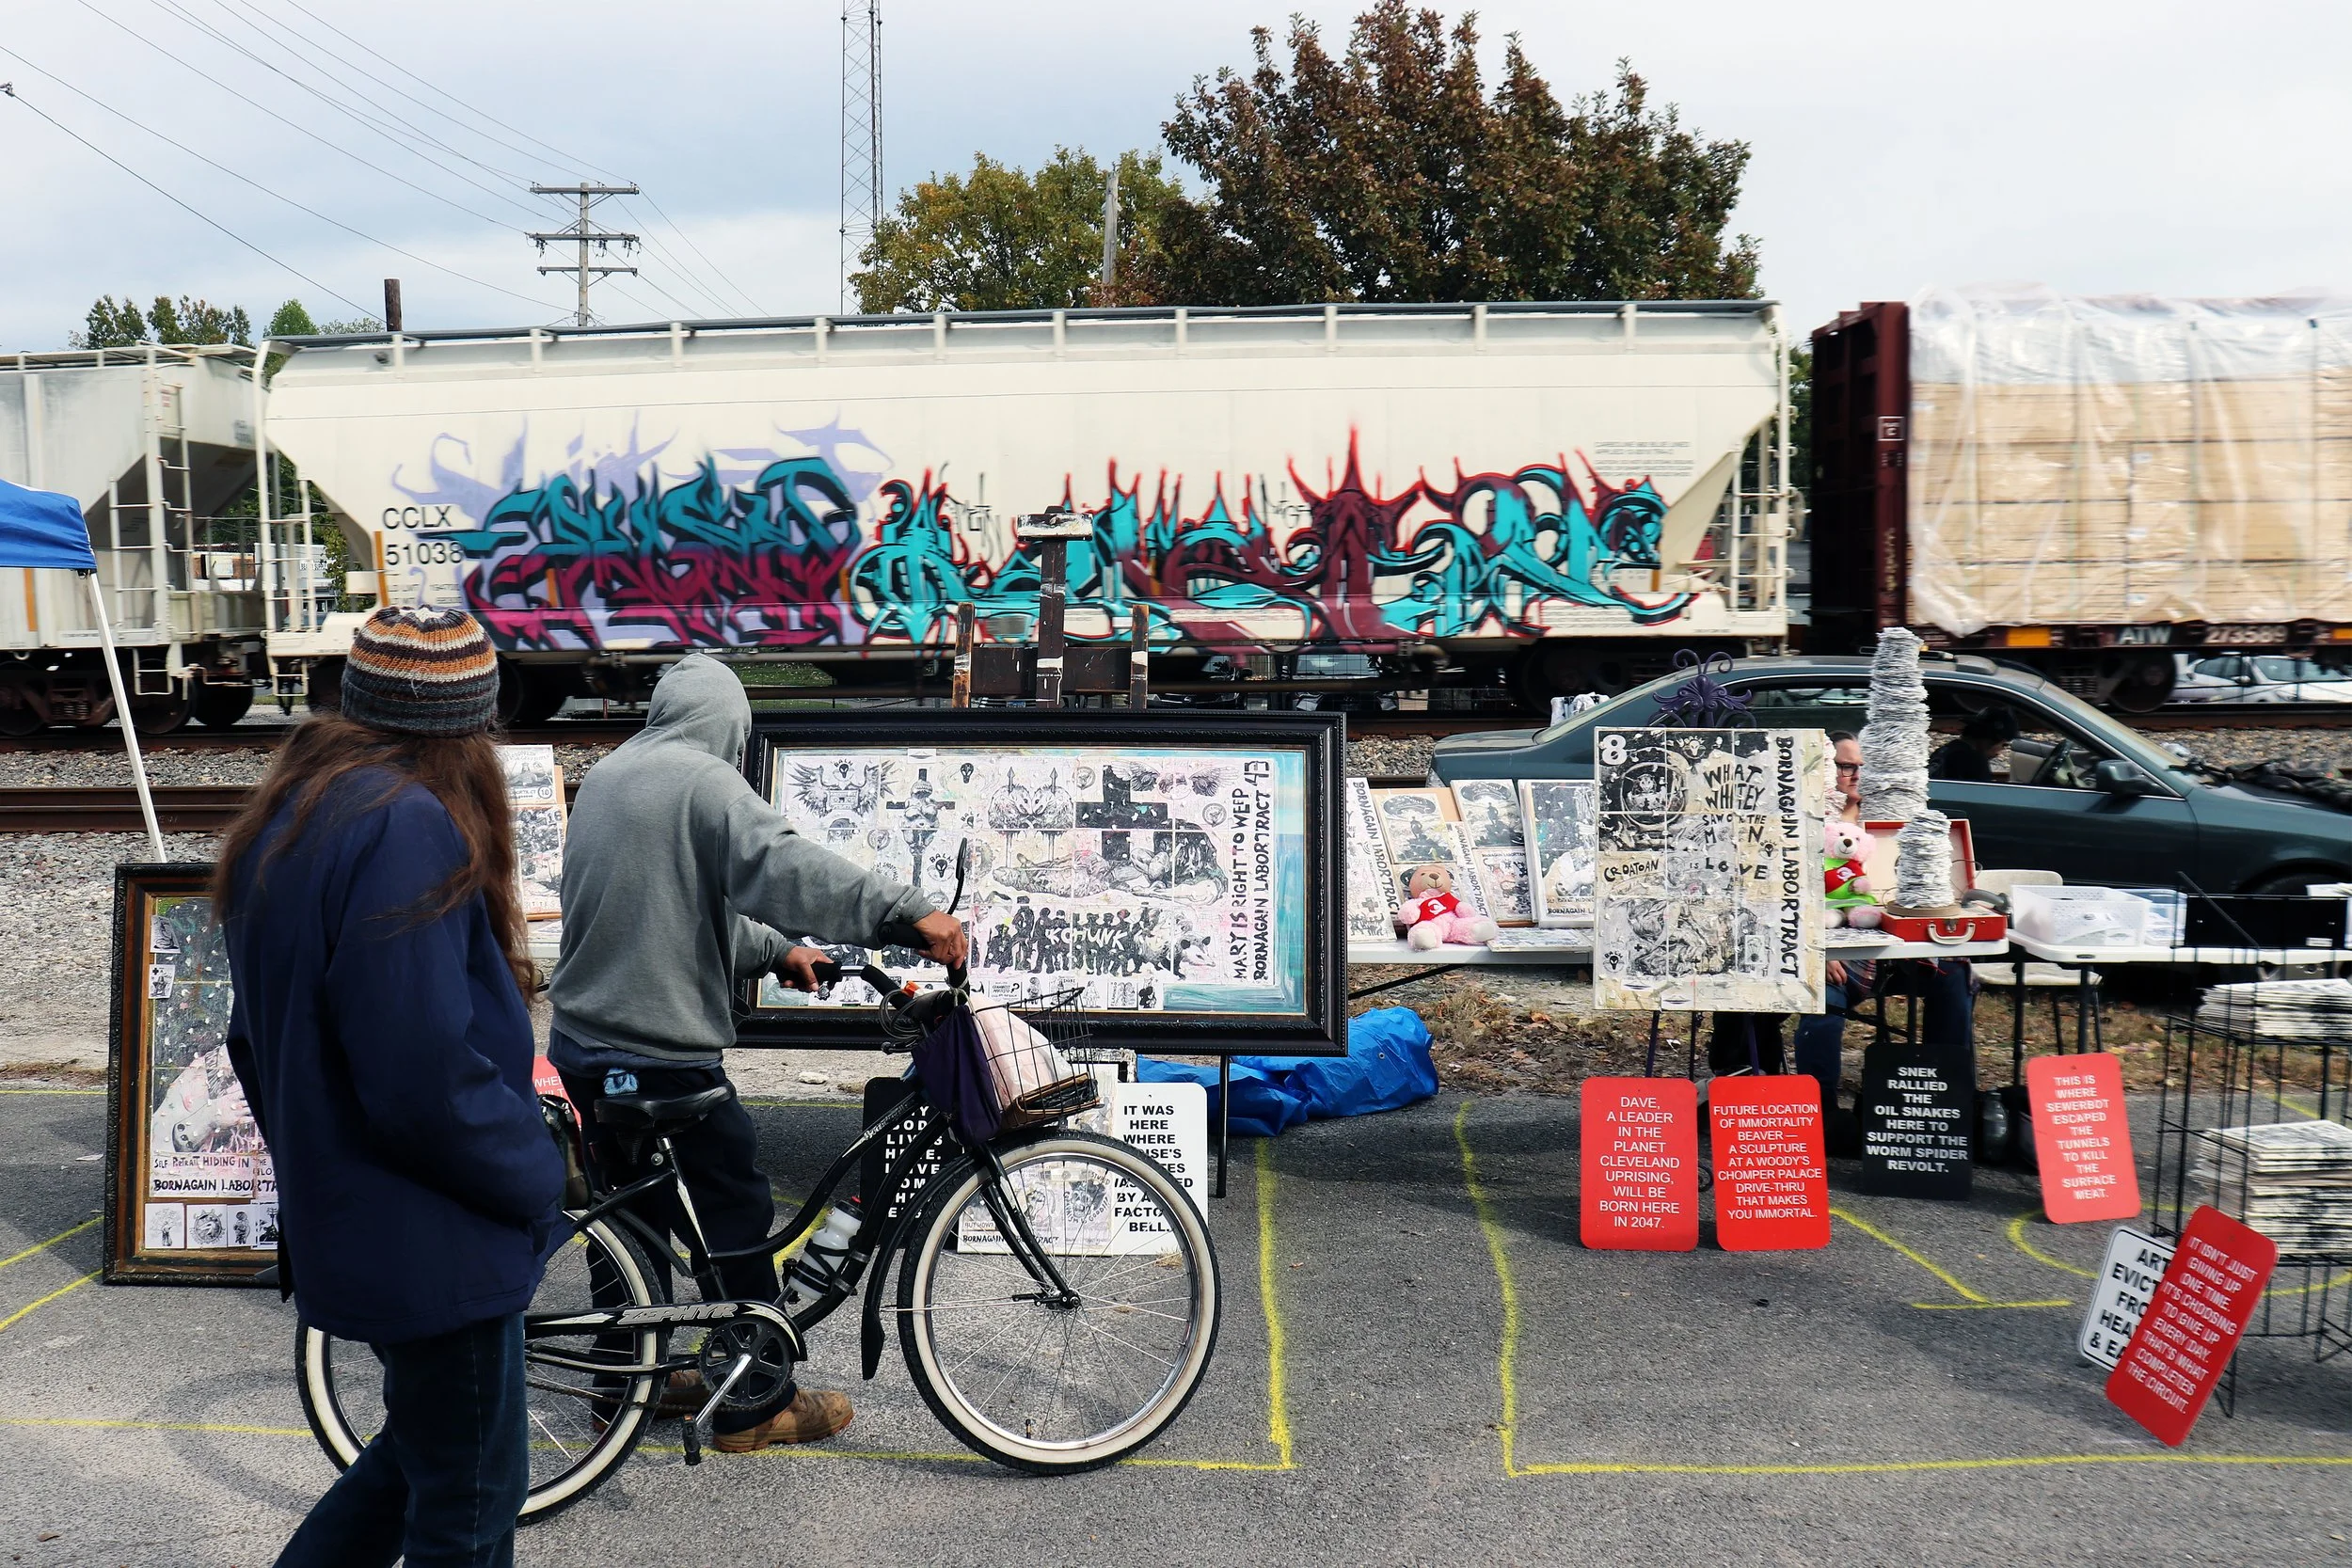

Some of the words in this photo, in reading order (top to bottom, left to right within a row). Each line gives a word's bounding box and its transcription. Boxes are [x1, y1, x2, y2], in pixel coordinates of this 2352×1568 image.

[382, 506, 453, 530] CCLX
[1601, 734, 1627, 765] 8
[1703, 764, 1763, 788] WHAT
[1705, 783, 1766, 811] WHITEY
[1775, 736, 1800, 847] BORNAGAIN
[1702, 814, 1724, 826] SAW
[1746, 815, 1767, 824] THE
[1232, 832, 1245, 855] TO
[1705, 857, 1768, 879] LOVE
[1230, 911, 1248, 928] IS
[1253, 898, 1269, 981] BORNAGAIN
[1230, 931, 1248, 979] MARY
[1898, 1067, 1937, 1077] SNEK
[1887, 1080, 1947, 1091] RALLIED
[2053, 1076, 2081, 1085] THIS
[2085, 1075, 2095, 1085] IS
[1903, 1094, 1931, 1104] THE
[2056, 1087, 2097, 1099] WHERE
[1621, 1097, 1660, 1110] DAVE,
[2045, 1100, 2110, 1113] SEWERBOT
[1123, 1105, 1137, 1116] IT
[1141, 1105, 1174, 1116] WAS
[1714, 1105, 1758, 1116] FUTURE
[1762, 1104, 1819, 1114] LOCATION
[1875, 1106, 1899, 1116] OIL
[1902, 1107, 1961, 1119] SNAKES
[1607, 1112, 1615, 1121] A
[1620, 1112, 1673, 1123] LEADER
[1720, 1119, 1735, 1128] OF
[1739, 1117, 1814, 1128] IMMORTALITY
[2053, 1112, 2106, 1125] ESCAPED
[1129, 1119, 1168, 1130] HERE
[1886, 1119, 1925, 1130] HERE
[1930, 1121, 1948, 1132] TO
[2070, 1125, 2093, 1135] THE
[1618, 1127, 1630, 1136] IN
[1635, 1127, 1661, 1137] THE
[1738, 1131, 1783, 1141] BEAVER
[1122, 1134, 1176, 1144] WHERE
[1867, 1132, 1935, 1145] SUPPORT
[1939, 1135, 1967, 1147] THE
[2057, 1137, 2110, 1150] TUNNELS
[1614, 1142, 1666, 1152] PLANET
[1729, 1145, 1737, 1154] A
[1740, 1143, 1806, 1154] SCULPTURE
[1867, 1146, 1912, 1157] WORM
[1915, 1148, 1968, 1160] SPIDER
[1600, 1156, 1679, 1168] CLEVELAND
[1728, 1157, 1742, 1166] AT
[1746, 1157, 1754, 1166] A
[1756, 1156, 1810, 1166] WOODY'S
[2063, 1151, 2079, 1162] TO
[2083, 1150, 2107, 1161] KILL
[202, 1158, 235, 1166] HIDING
[238, 1158, 249, 1167] IN
[1887, 1161, 1948, 1173] REVOLT.
[1718, 1170, 1775, 1180] CHOMPER
[1779, 1168, 1821, 1180] PALACE
[2076, 1164, 2100, 1174] THE
[1606, 1171, 1675, 1184] UPRISING,
[2062, 1176, 2116, 1188] SURFACE
[153, 1180, 216, 1191] BORNAGAIN
[1613, 1186, 1645, 1197] WILL
[1648, 1187, 1665, 1197] BE
[1736, 1182, 1804, 1193] DRIVE-THRU
[1117, 1192, 1136, 1202] BY
[2074, 1188, 2108, 1200] MEAT.
[1736, 1196, 1765, 1206] THAT
[1769, 1195, 1807, 1205] MAKES
[1599, 1201, 1638, 1212] BORN
[1643, 1203, 1679, 1213] HERE
[1727, 1210, 1752, 1219] YOU
[1756, 1209, 1817, 1219] IMMORTAL.
[1129, 1222, 1170, 1232] BELL.
[1614, 1216, 1628, 1227] IN
[1631, 1217, 1664, 1228] 2047.
[2187, 1236, 2201, 1251] IT
[2199, 1242, 2229, 1264] ISN'T
[2226, 1259, 2258, 1282] JUST
[2187, 1258, 2225, 1285] GIVING
[2224, 1277, 2242, 1293] UP
[2180, 1273, 2204, 1293] ONE
[2203, 1285, 2232, 1312] TIME.
[616, 1303, 739, 1325] ZEPHYR
[2163, 1282, 2182, 1300] IT'S
[2181, 1291, 2237, 1335] CHOOSING
[2163, 1302, 2179, 1318] TO
[2179, 1310, 2203, 1336] GIVE
[2202, 1327, 2220, 1344] UP
[2153, 1318, 2185, 1346] EVERY
[2185, 1338, 2211, 1363] DAY.
[2141, 1330, 2177, 1360] THAT'S
[2177, 1352, 2209, 1381] WHAT
[2135, 1347, 2196, 1396] COMPLETES
[2126, 1362, 2147, 1383] THE
[2145, 1376, 2188, 1414] CIRCUIT.
